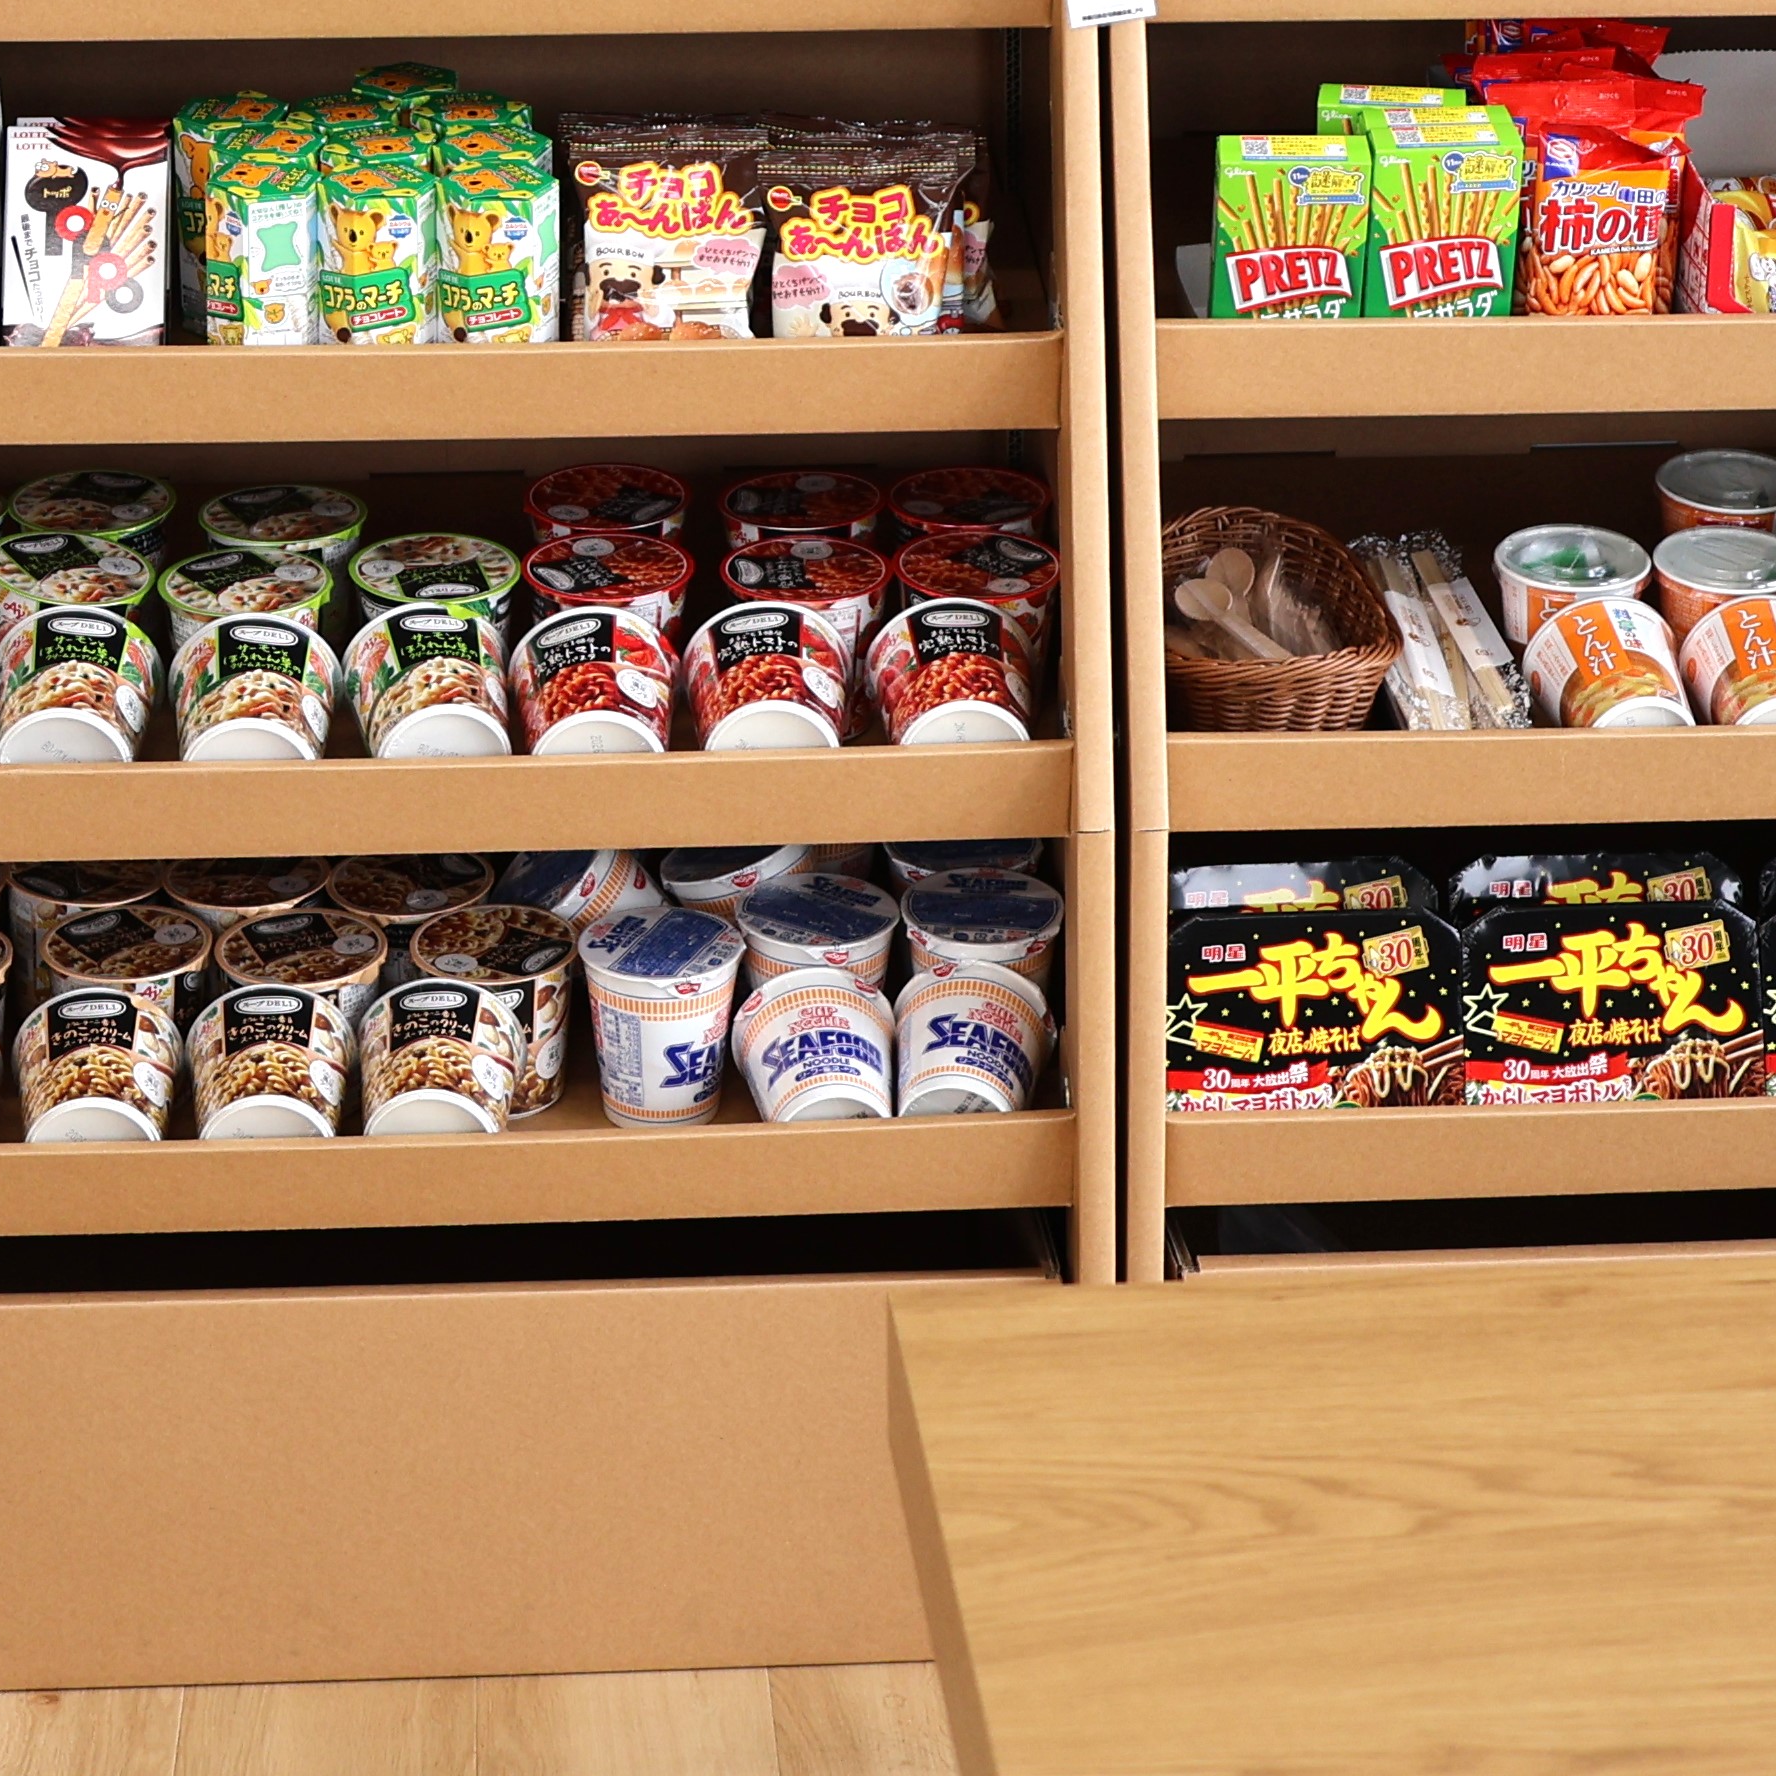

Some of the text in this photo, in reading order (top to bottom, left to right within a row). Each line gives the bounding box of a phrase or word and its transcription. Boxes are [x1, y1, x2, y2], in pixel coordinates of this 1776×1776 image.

[1321, 109, 1353, 120] Glico
[1225, 166, 1256, 176] Glico
[1379, 155, 1411, 165] Glico
[625, 168, 719, 200] チョコ
[1552, 181, 1617, 197] カリッと!
[815, 191, 910, 225] チョコ
[1540, 199, 1665, 255] 柿の種
[596, 246, 646, 260] BOURBON
[1235, 250, 1342, 302] PRETZ
[1389, 240, 1494, 298] PRETZ
[324, 281, 402, 311] コアラのマーチ
[442, 283, 522, 312] コアラのマーチ
[837, 288, 884, 300] BOURBON
[353, 310, 403, 325] チョコレート
[469, 308, 519, 324] チョコレート
[1574, 615, 1616, 675] とん汁
[1738, 610, 1776, 670] とん汁
[1201, 944, 1246, 963] 明星
[1502, 932, 1548, 952] 明星
[1187, 930, 1441, 1042] 一平ちゃん
[1488, 922, 1744, 1039] 一平ちゃん
[1268, 1026, 1362, 1056] 夜店の焼そば
[1568, 1018, 1662, 1047] 夜店の焼そば
[762, 1031, 883, 1090] SEAFOOD
[803, 1057, 850, 1068] NOODLE
[1202, 1059, 1310, 1090] 30周年 大放出祭
[1504, 1052, 1610, 1080] 30周年 大放出祭
